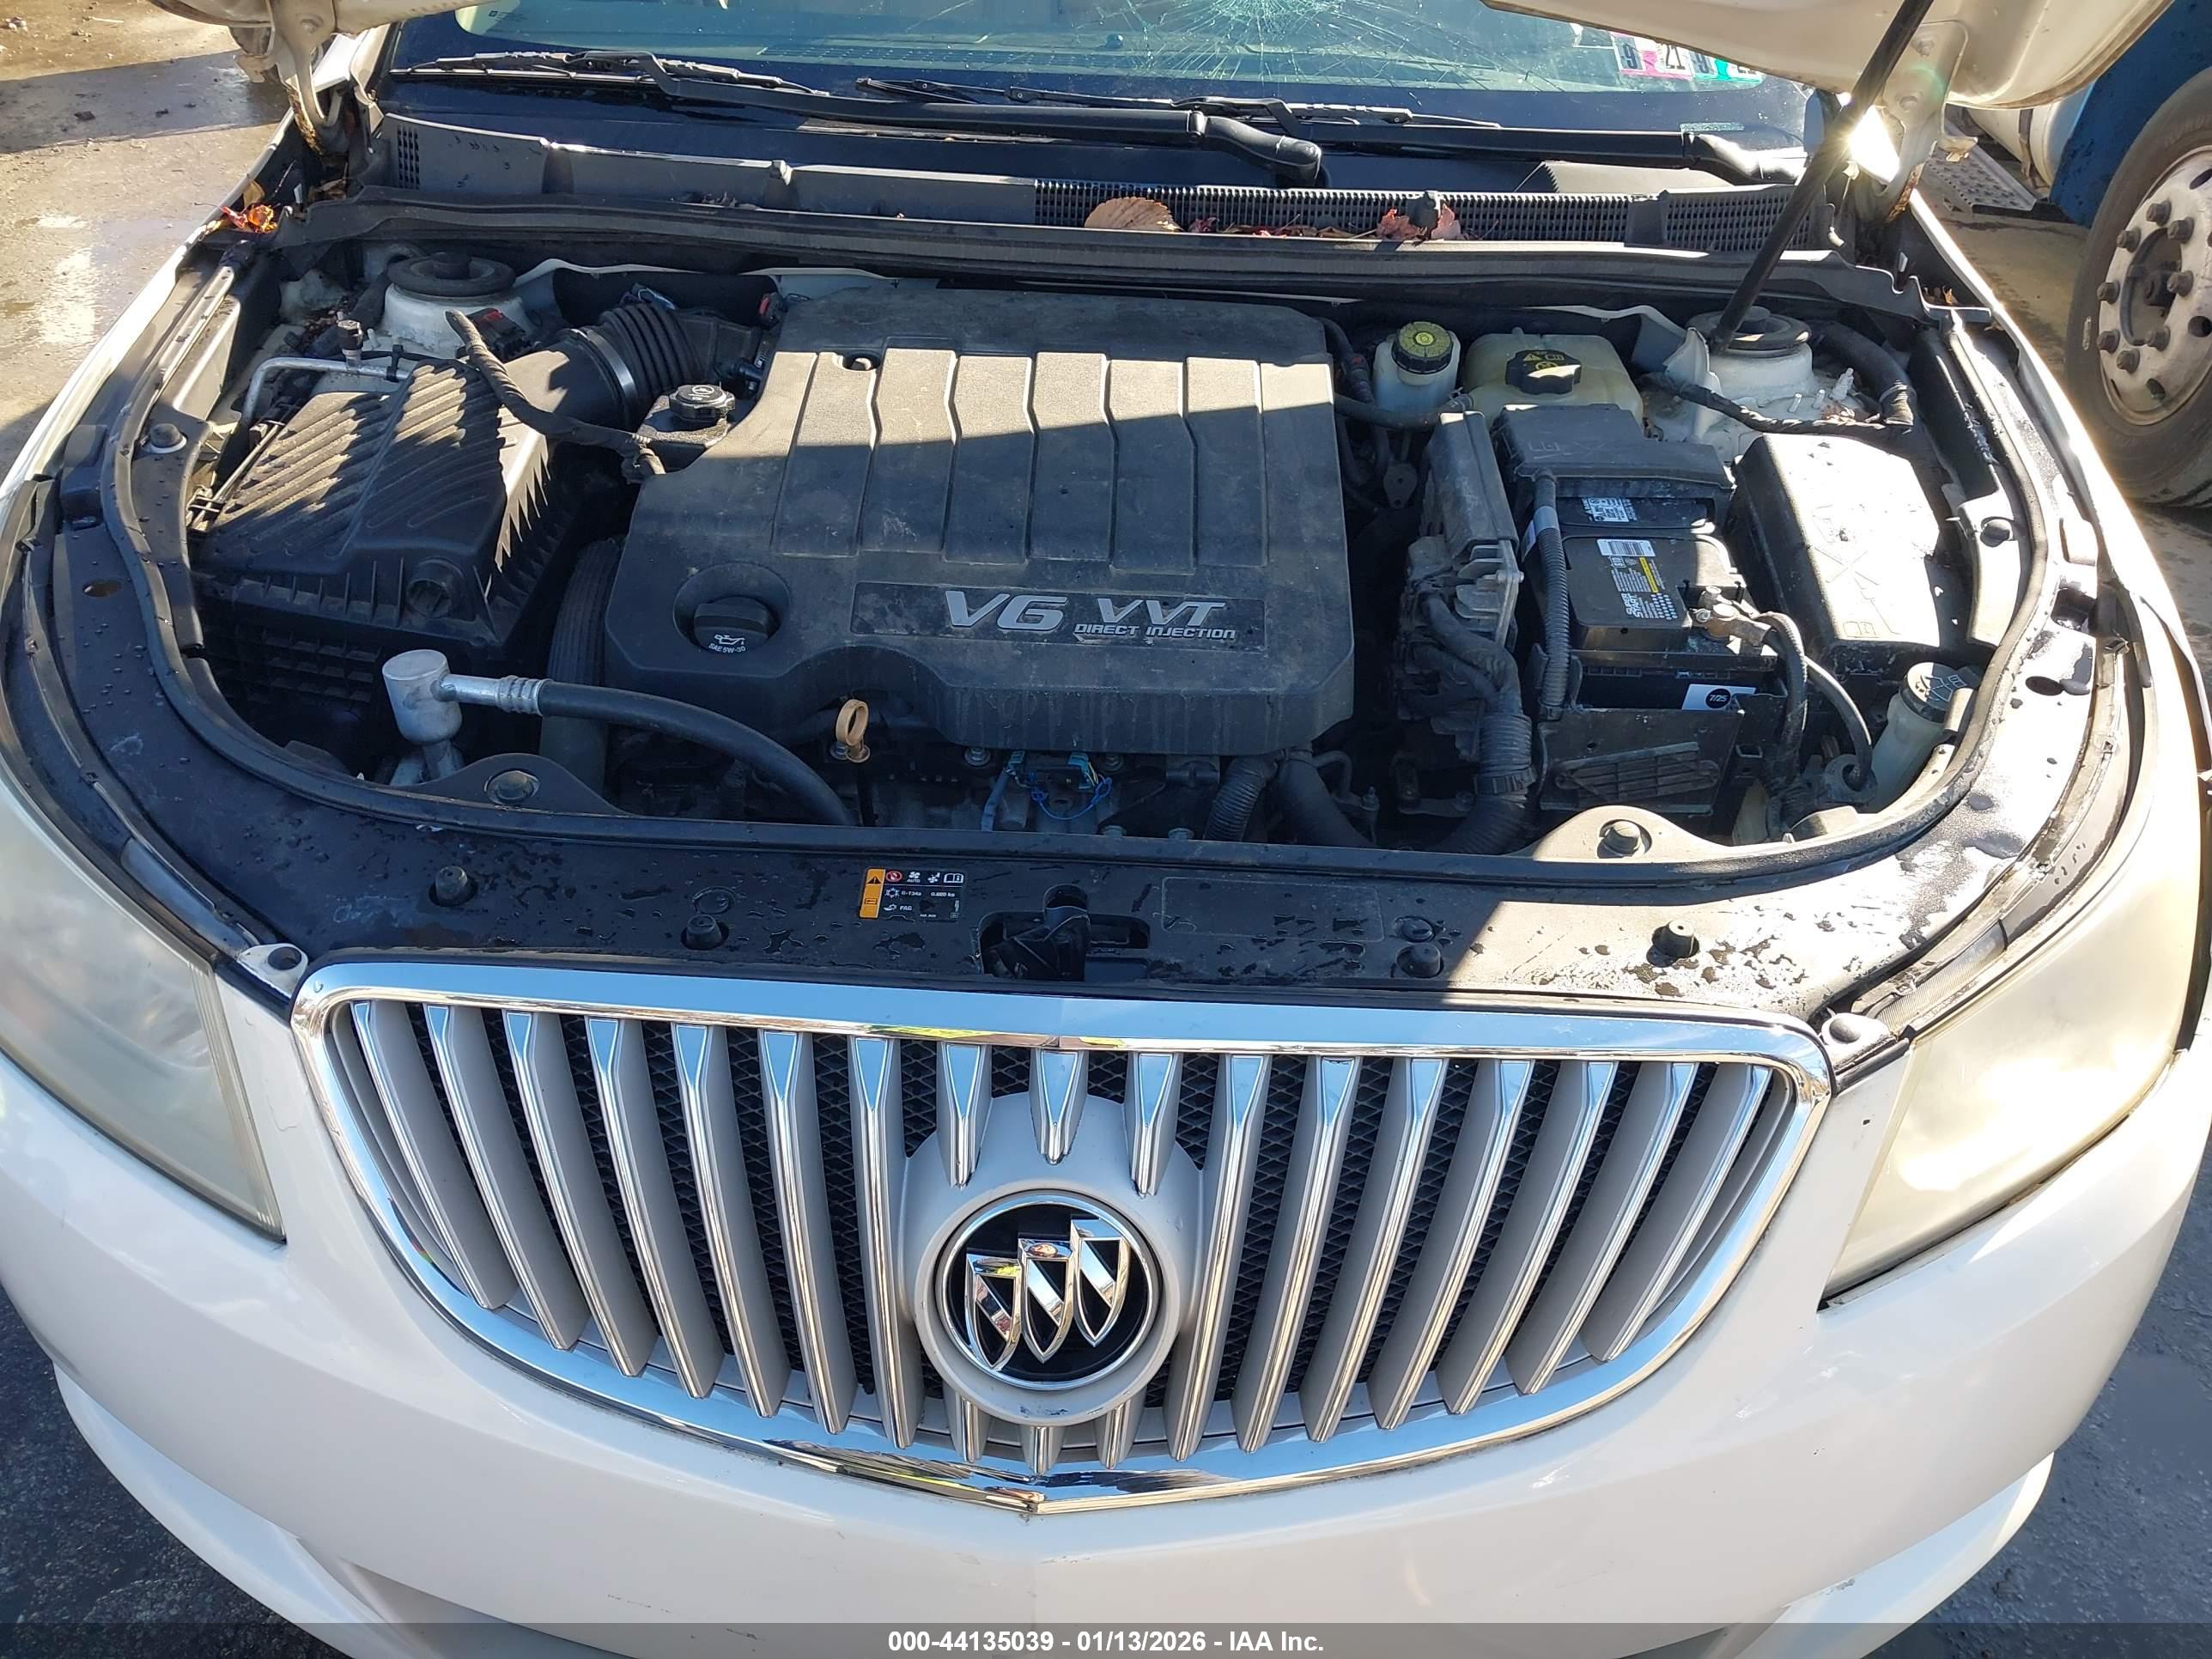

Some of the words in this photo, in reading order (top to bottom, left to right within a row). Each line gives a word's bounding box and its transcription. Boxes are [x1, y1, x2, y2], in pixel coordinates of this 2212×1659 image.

[1623, 43, 1636, 69] 9
[945, 590, 1069, 632] V6
[1097, 598, 1226, 626] VVT
[1074, 623, 1140, 635] DIRECT
[1146, 627, 1236, 640] INJECTION
[708, 642, 722, 652] SAE
